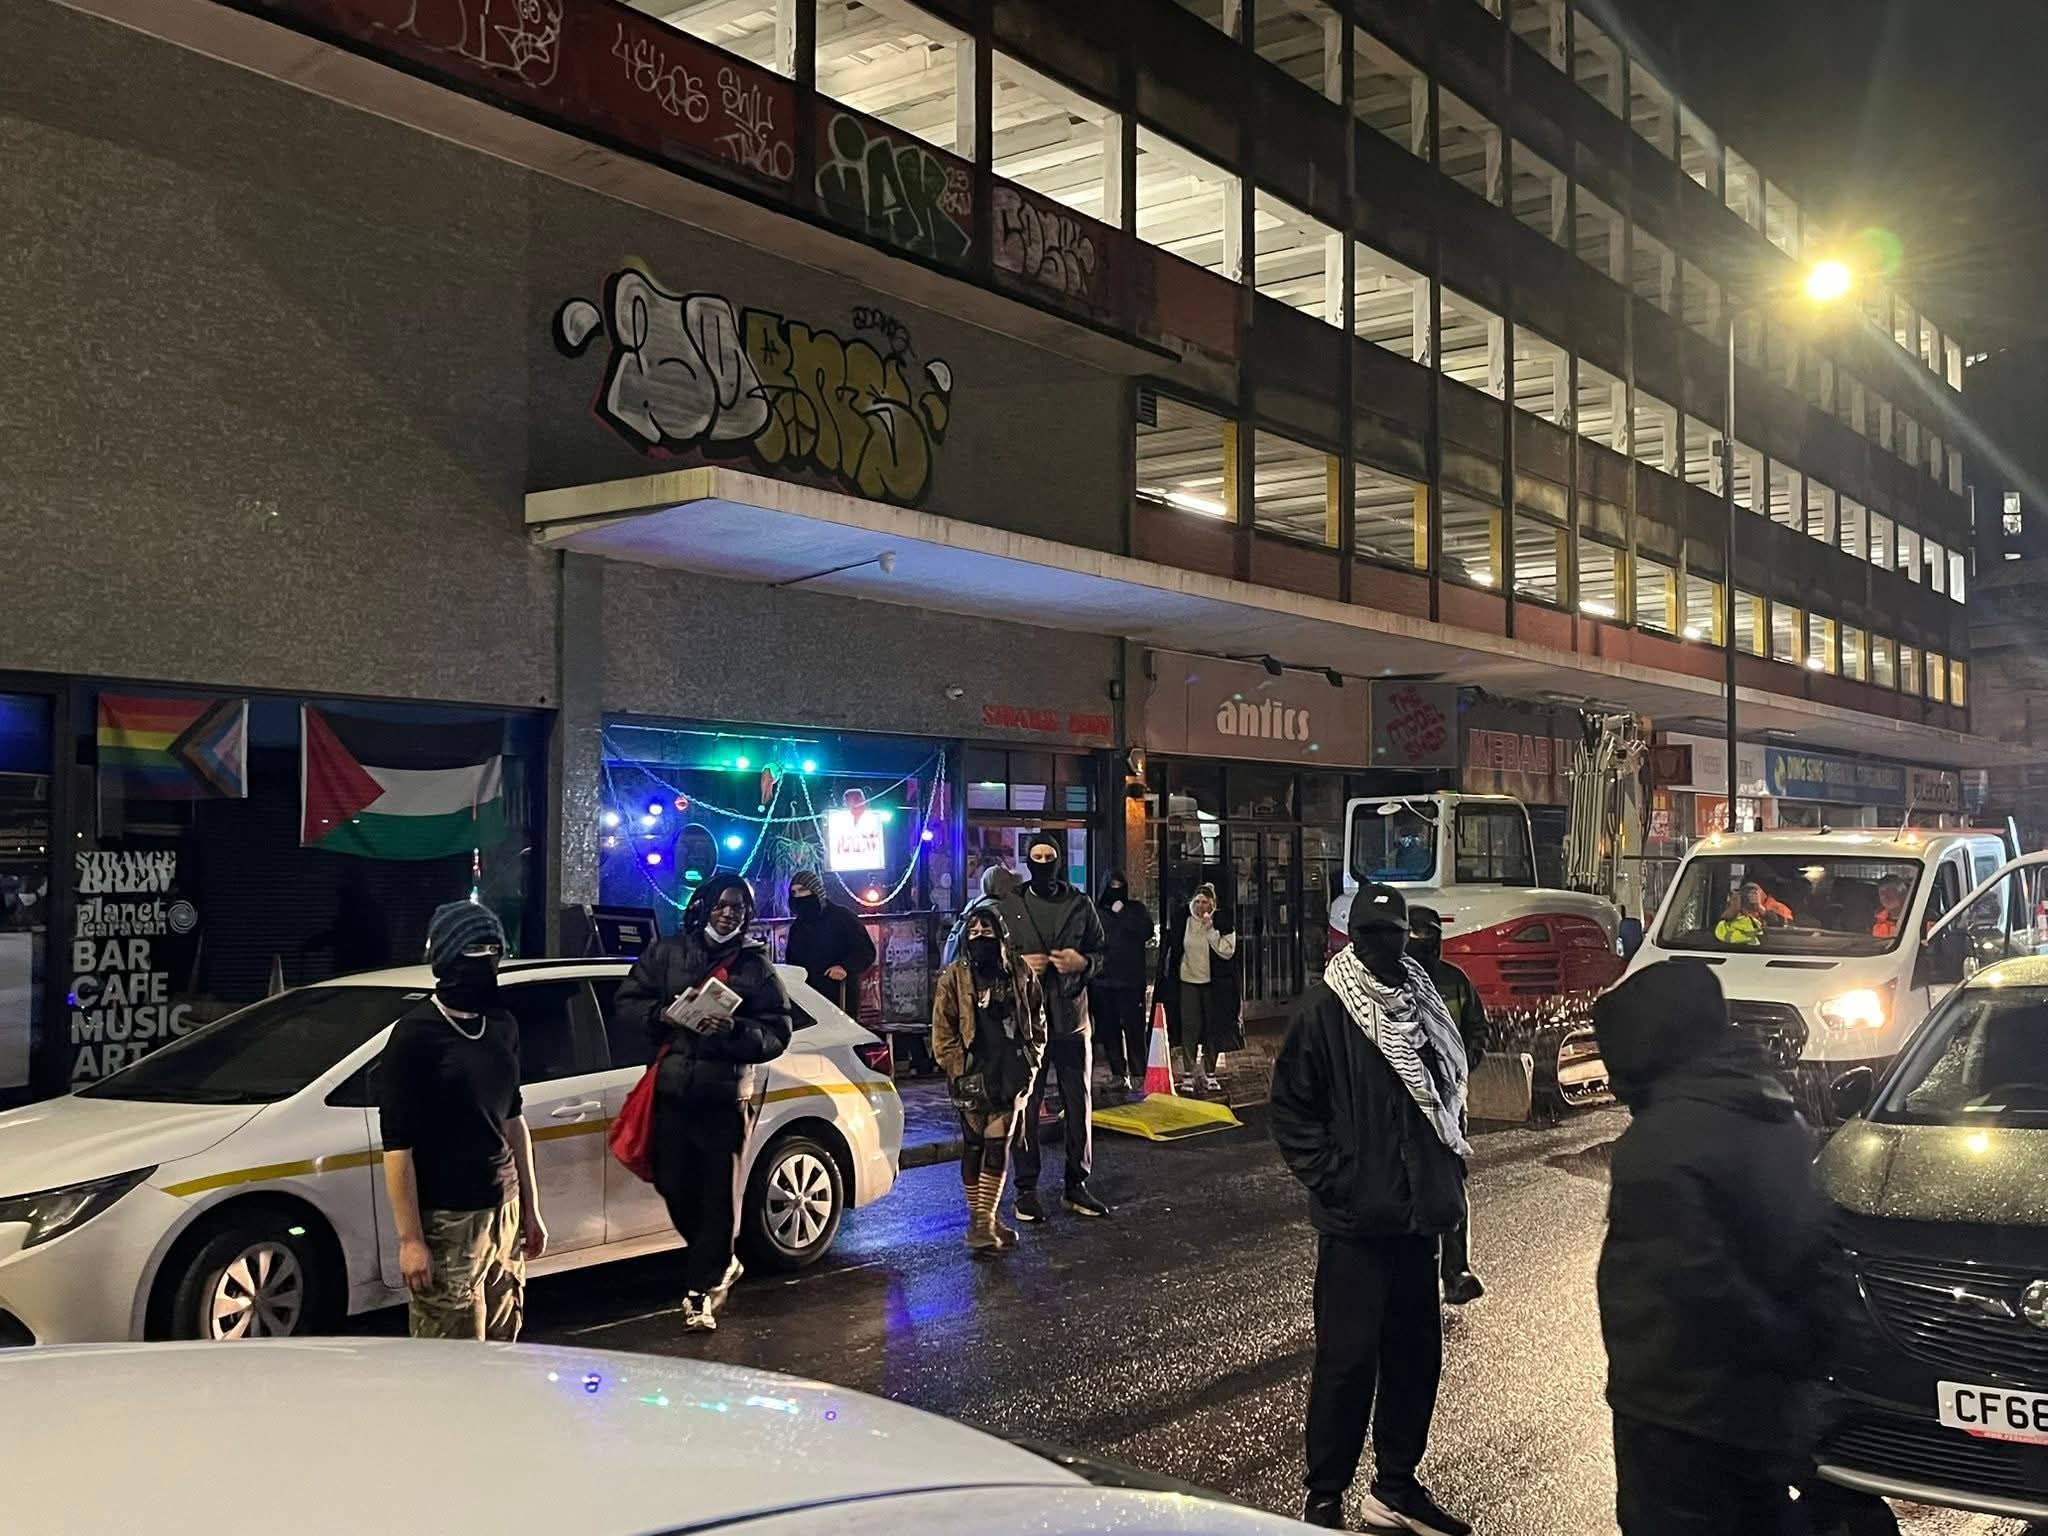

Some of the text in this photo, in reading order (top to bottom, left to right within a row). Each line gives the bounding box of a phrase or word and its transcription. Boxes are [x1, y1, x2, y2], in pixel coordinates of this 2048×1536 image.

[1216, 698, 1310, 741] antics
[1386, 702, 1446, 745] MODEL
[1468, 727, 1551, 775] KEBAB
[75, 850, 176, 877] STRANGE
[79, 866, 172, 894] BREW
[84, 920, 168, 937] caravan
[72, 938, 152, 973] BAR
[69, 971, 169, 1008] CAFE
[71, 1003, 193, 1044] MUSIC
[71, 1041, 149, 1080] ART
